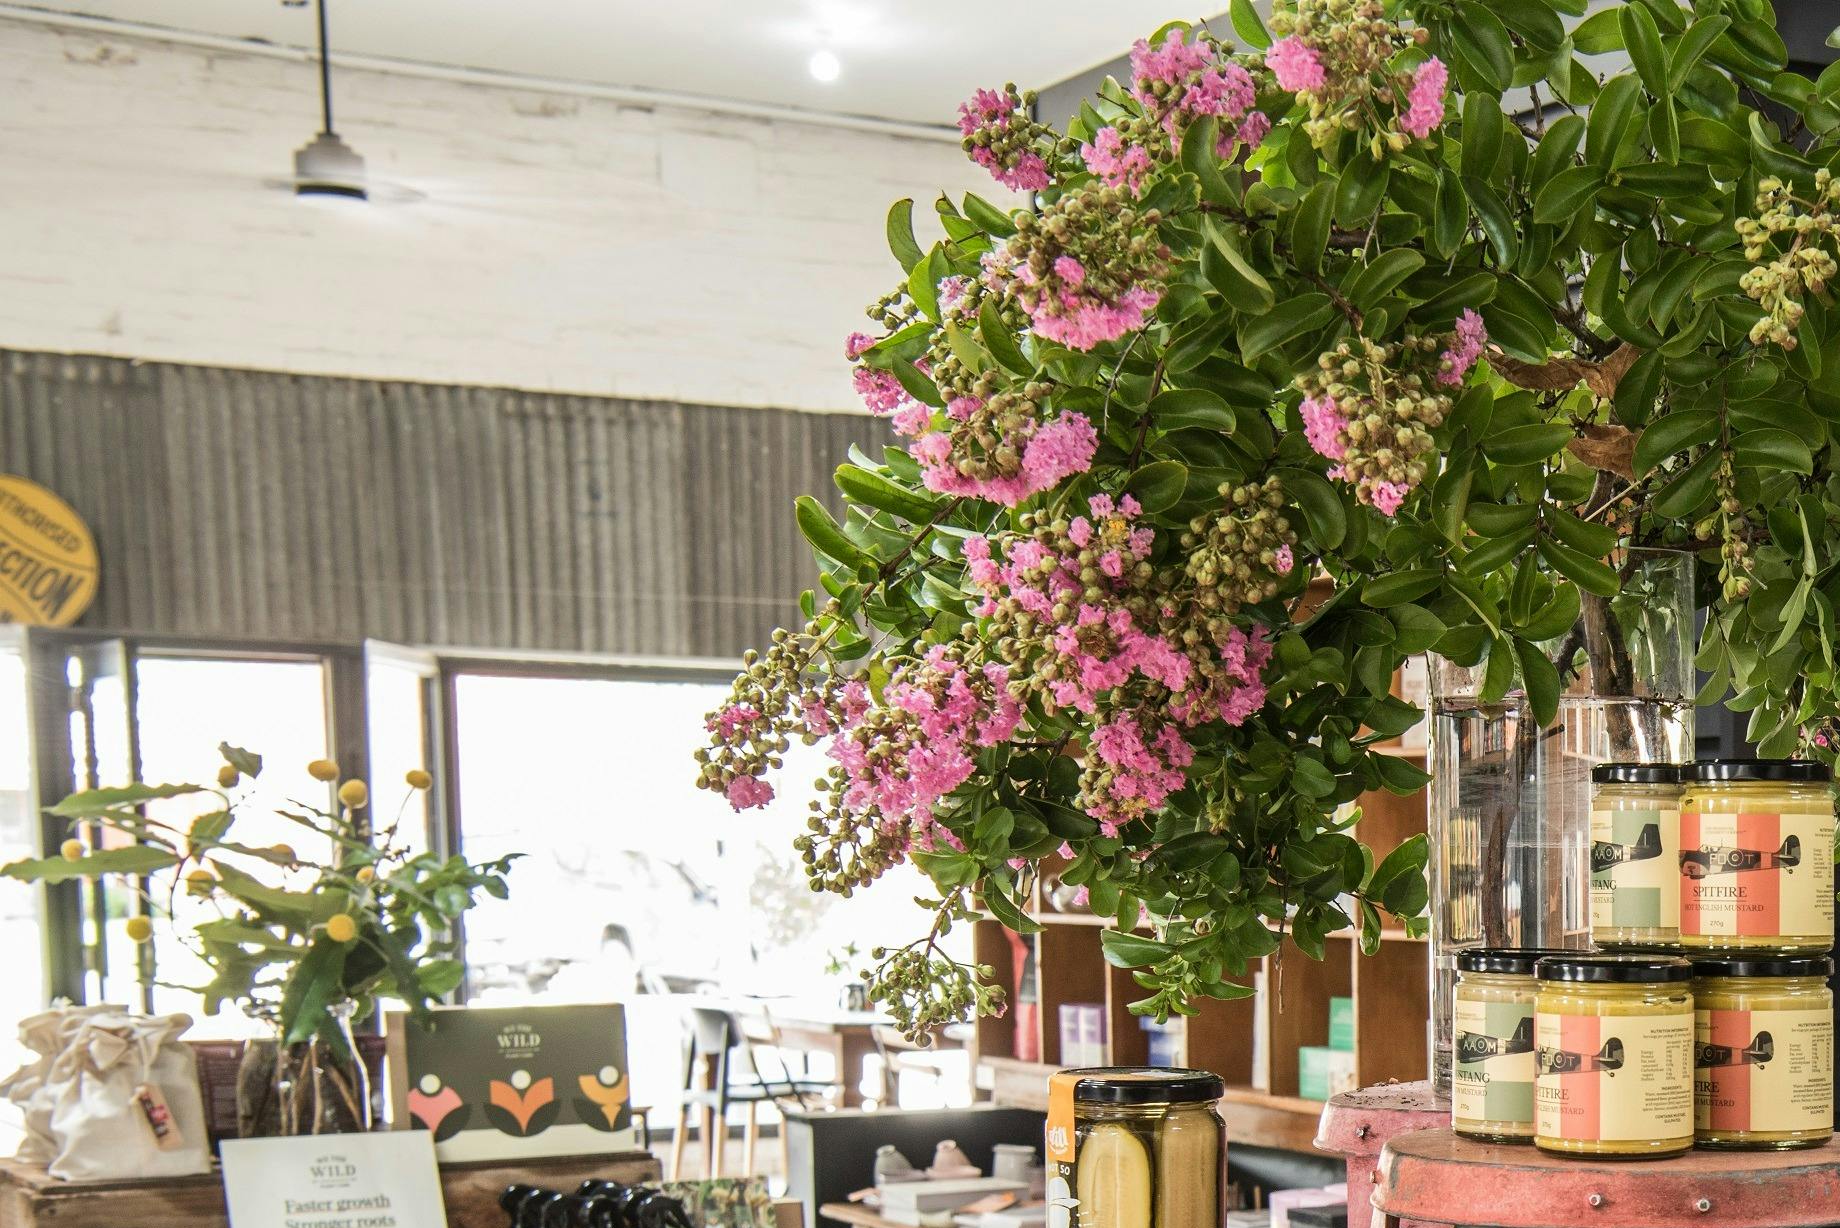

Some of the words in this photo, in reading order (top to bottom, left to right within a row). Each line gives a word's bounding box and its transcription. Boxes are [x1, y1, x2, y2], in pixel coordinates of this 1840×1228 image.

[1692, 886, 1748, 898] SPITFIRE
[1695, 903, 1723, 911] ENGLISH
[1723, 903, 1765, 912] MUSTARD
[1709, 920, 1724, 928] 270g
[497, 1035, 541, 1048] WILD
[1456, 1070, 1491, 1084] STANG
[1700, 1099, 1735, 1107] MUSTARD
[1552, 1106, 1585, 1116] MUSTARD
[310, 1165, 356, 1178] WILD
[1059, 1164, 1071, 1176] SO
[285, 1198, 334, 1214] Faster
[336, 1194, 391, 1212] growth
[356, 1215, 396, 1228] roots
